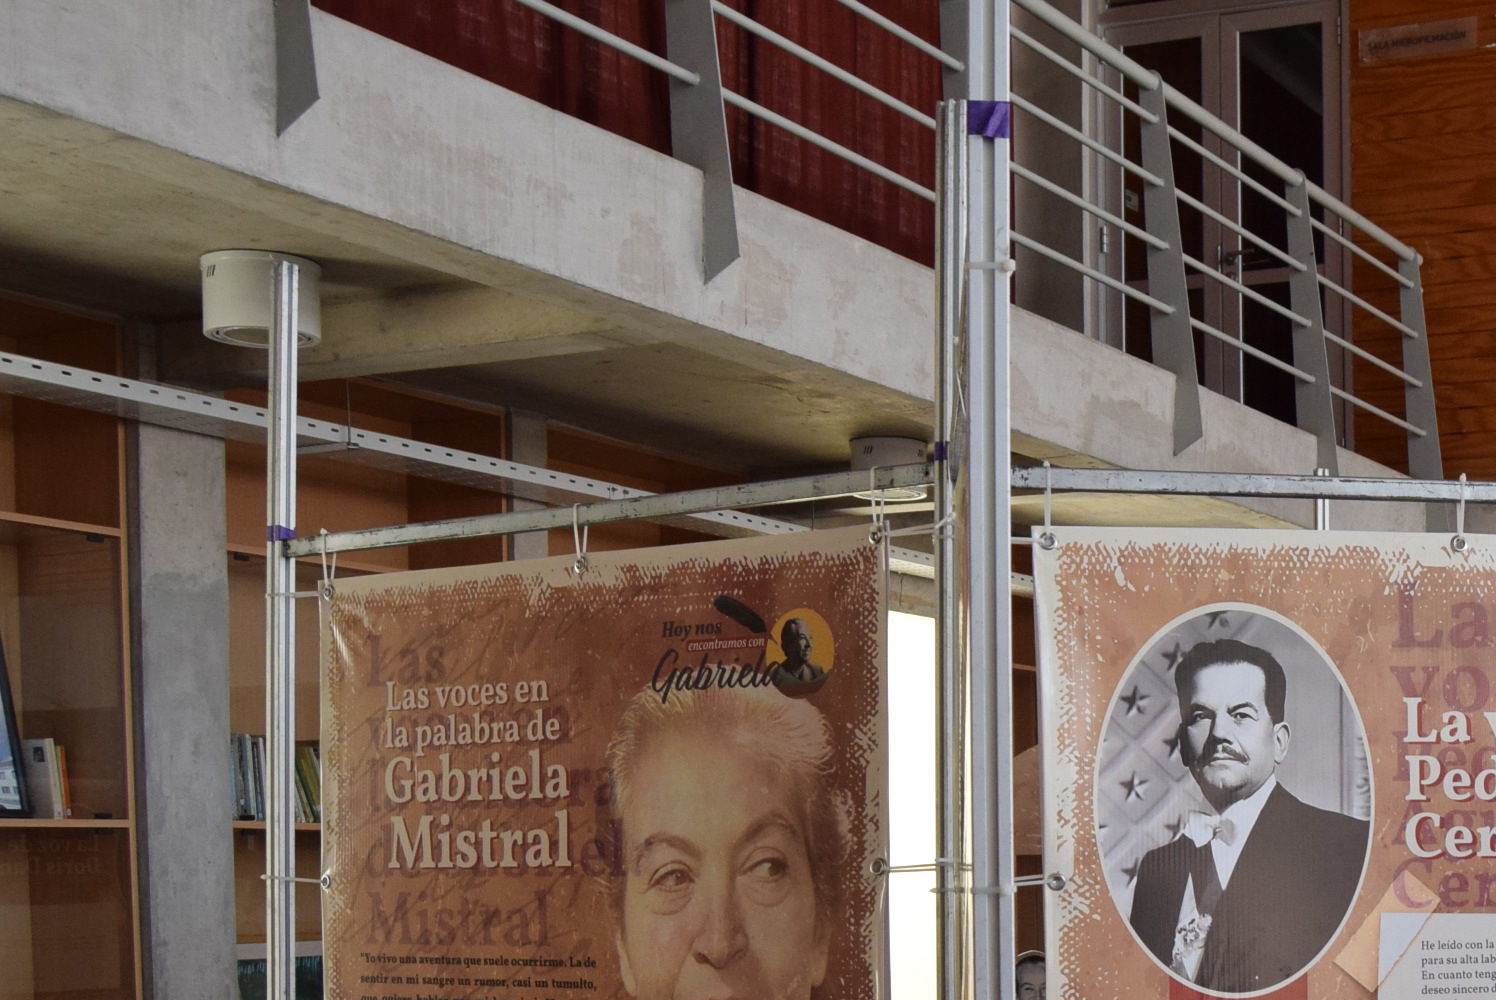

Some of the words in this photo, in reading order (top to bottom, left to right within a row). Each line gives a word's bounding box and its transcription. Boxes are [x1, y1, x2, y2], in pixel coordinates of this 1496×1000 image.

[662, 621, 691, 641] Hoy
[695, 622, 722, 636] nos
[688, 638, 747, 651] encontramos
[748, 637, 765, 647] con
[651, 649, 782, 704] Gabriela
[386, 680, 430, 712] Las
[434, 682, 508, 708] voces
[514, 679, 549, 703] en
[1403, 697, 1471, 743] La
[384, 715, 409, 749] la
[414, 710, 520, 757] palabra
[526, 709, 560, 740] de
[383, 749, 571, 804] Gabriela
[388, 809, 572, 870] Mistral
[1421, 940, 1436, 950] He
[1437, 940, 1463, 950] leído
[1485, 939, 1495, 948] la
[377, 954, 397, 963] vivo
[419, 957, 461, 965] aventura
[464, 958, 481, 968] que
[484, 956, 509, 966] suele
[511, 958, 567, 967] ocurrirme.
[569, 957, 582, 967] La
[583, 958, 596, 967] de
[1421, 958, 1444, 968] para
[1460, 954, 1479, 964] alta
[361, 974, 389, 983] sentir
[406, 975, 419, 984] mi
[422, 976, 454, 988] sangre
[474, 979, 509, 988] rumor,
[512, 978, 531, 987] casi
[552, 979, 596, 990] tumulto,
[1421, 970, 1435, 980] En
[1437, 971, 1473, 979] cuanto
[1421, 985, 1450, 994] deseo
[1452, 984, 1490, 994] sincero
